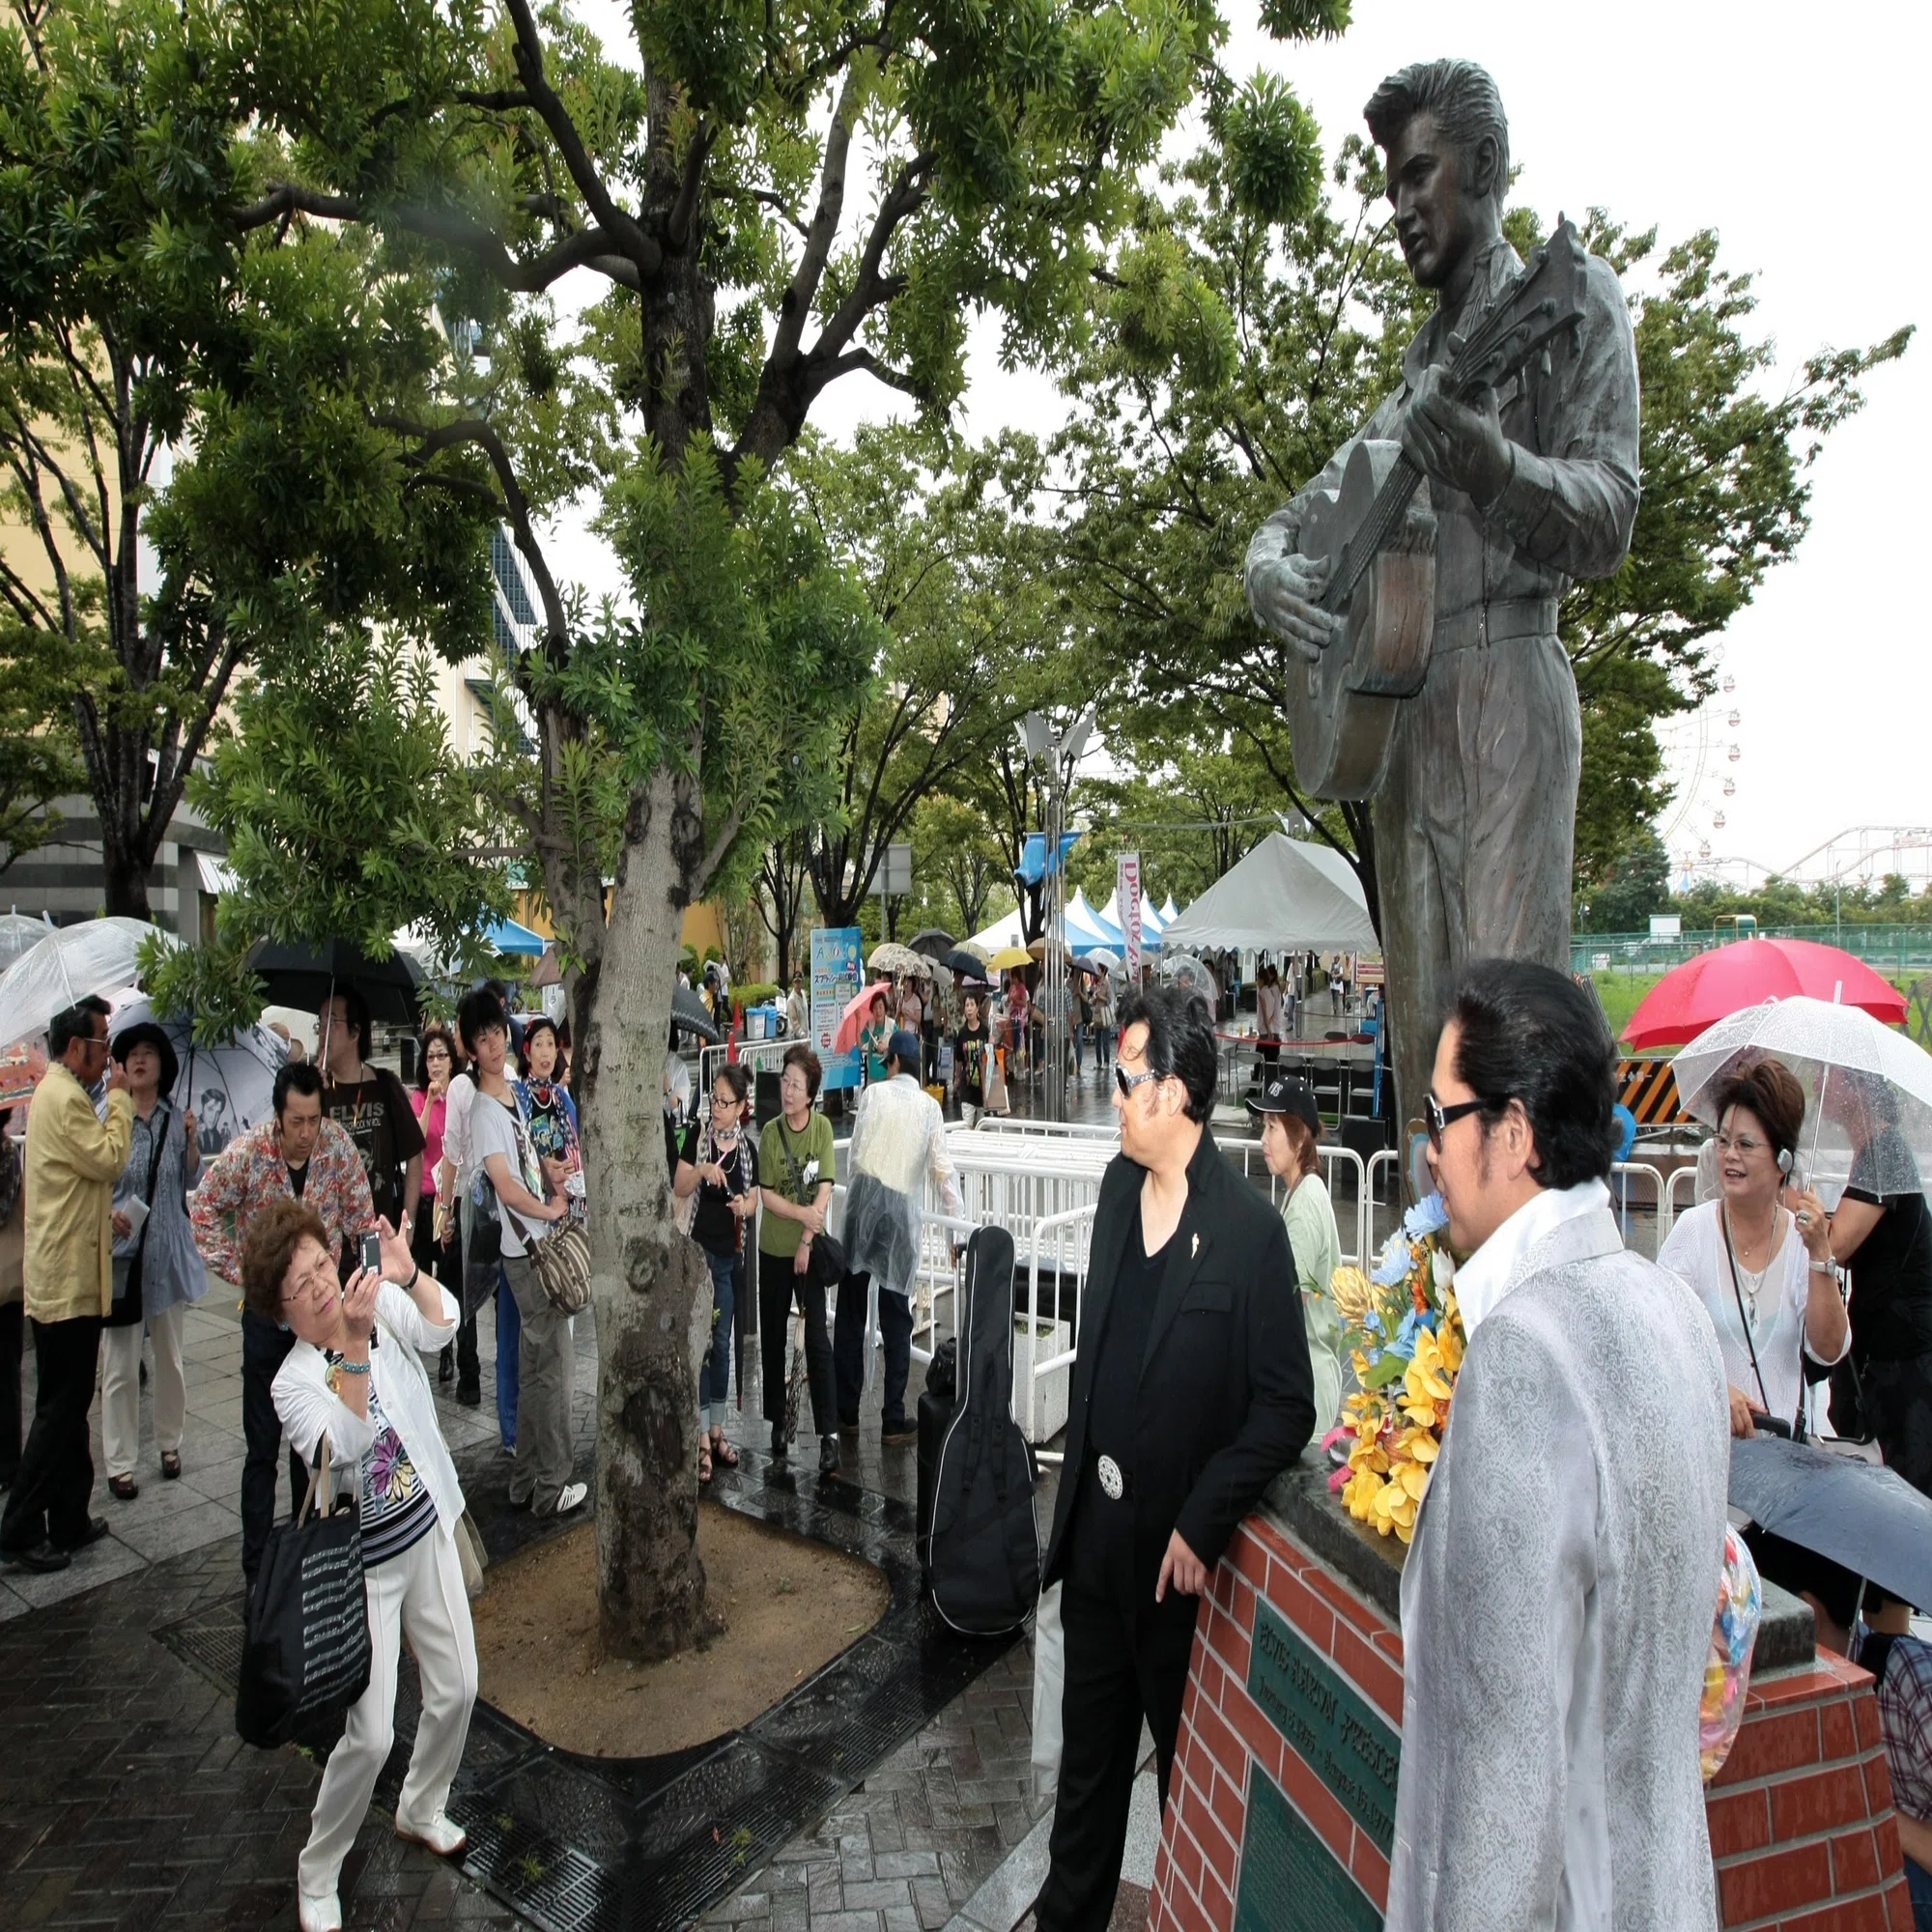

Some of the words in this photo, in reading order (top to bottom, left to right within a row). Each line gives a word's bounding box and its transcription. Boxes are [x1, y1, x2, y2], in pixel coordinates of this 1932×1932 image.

[1124, 862, 1141, 943] Doctor
[329, 1102, 384, 1121] ELVIS
[1260, 1622, 1291, 1673] ELVIS
[1292, 1656, 1339, 1725] AARON
